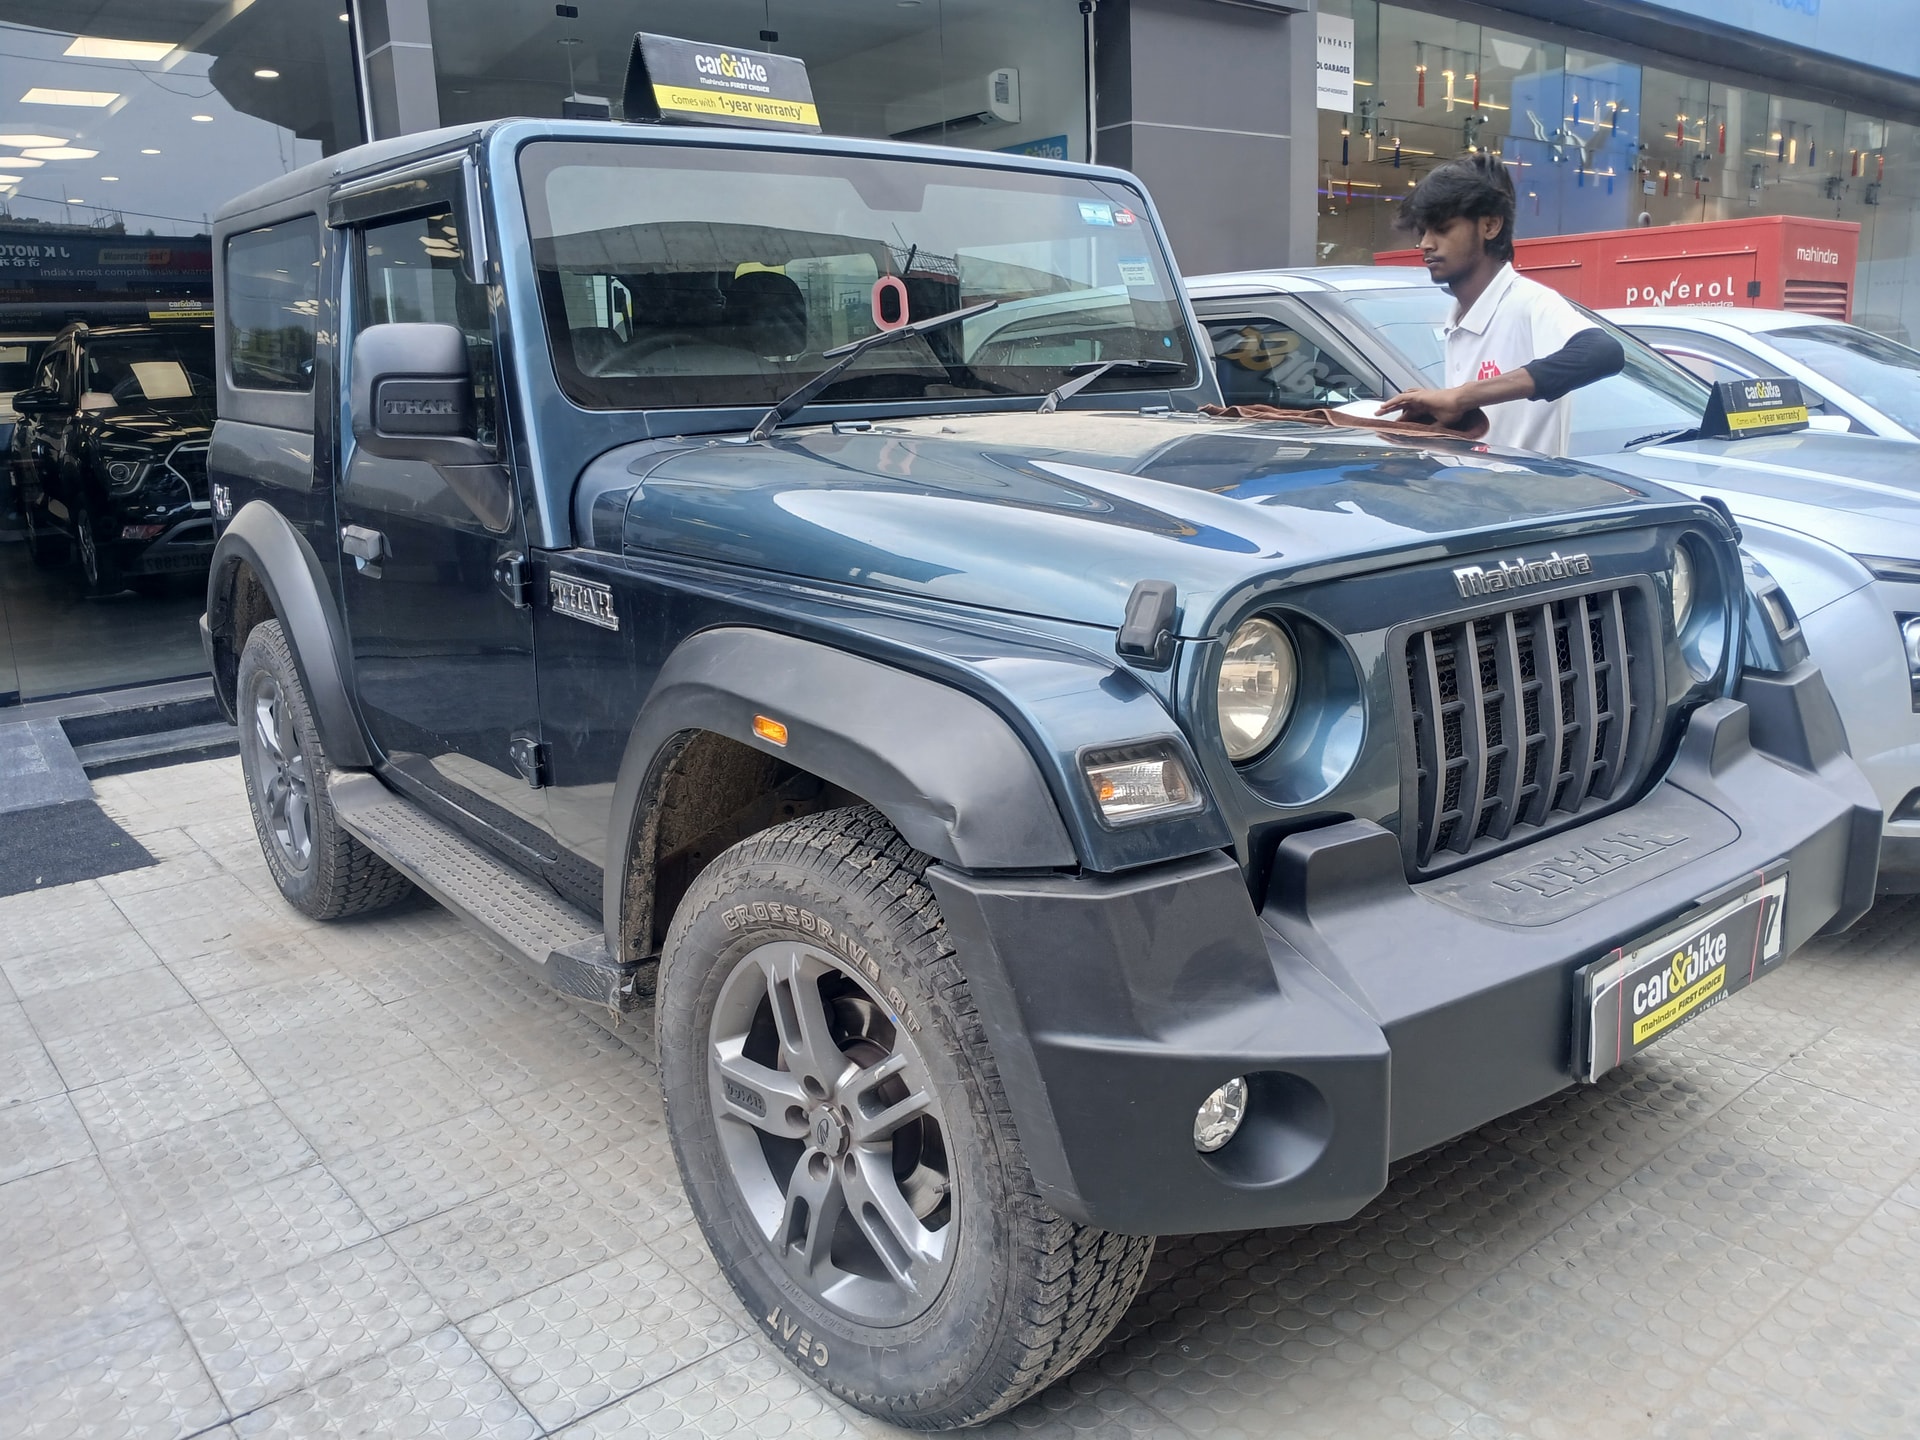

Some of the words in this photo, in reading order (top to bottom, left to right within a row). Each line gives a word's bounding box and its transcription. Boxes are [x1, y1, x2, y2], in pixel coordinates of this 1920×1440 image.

[1318, 36, 1352, 49] VINFAST
[695, 53, 768, 82] car&bike
[1324, 63, 1350, 74] GARAGES
[671, 94, 699, 108] Comes
[700, 97, 717, 109] with
[718, 96, 752, 113] 1-year
[1797, 247, 1838, 265] mahindra
[40, 268, 74, 277] India's
[76, 269, 102, 277] most
[1626, 273, 1734, 307] powerol
[1744, 381, 1781, 399] car&bike
[384, 399, 460, 415] THAR
[1453, 551, 1593, 598] Mahindra
[551, 576, 619, 627] THAR
[721, 901, 882, 982] CROSSDRIVE
[1633, 931, 1727, 1016] car&bike
[1641, 1006, 1677, 1034] Mahindra
[1678, 990, 1698, 1011] FIRST
[1698, 974, 1722, 997] CHOICE
[766, 1304, 829, 1367] CEAT
